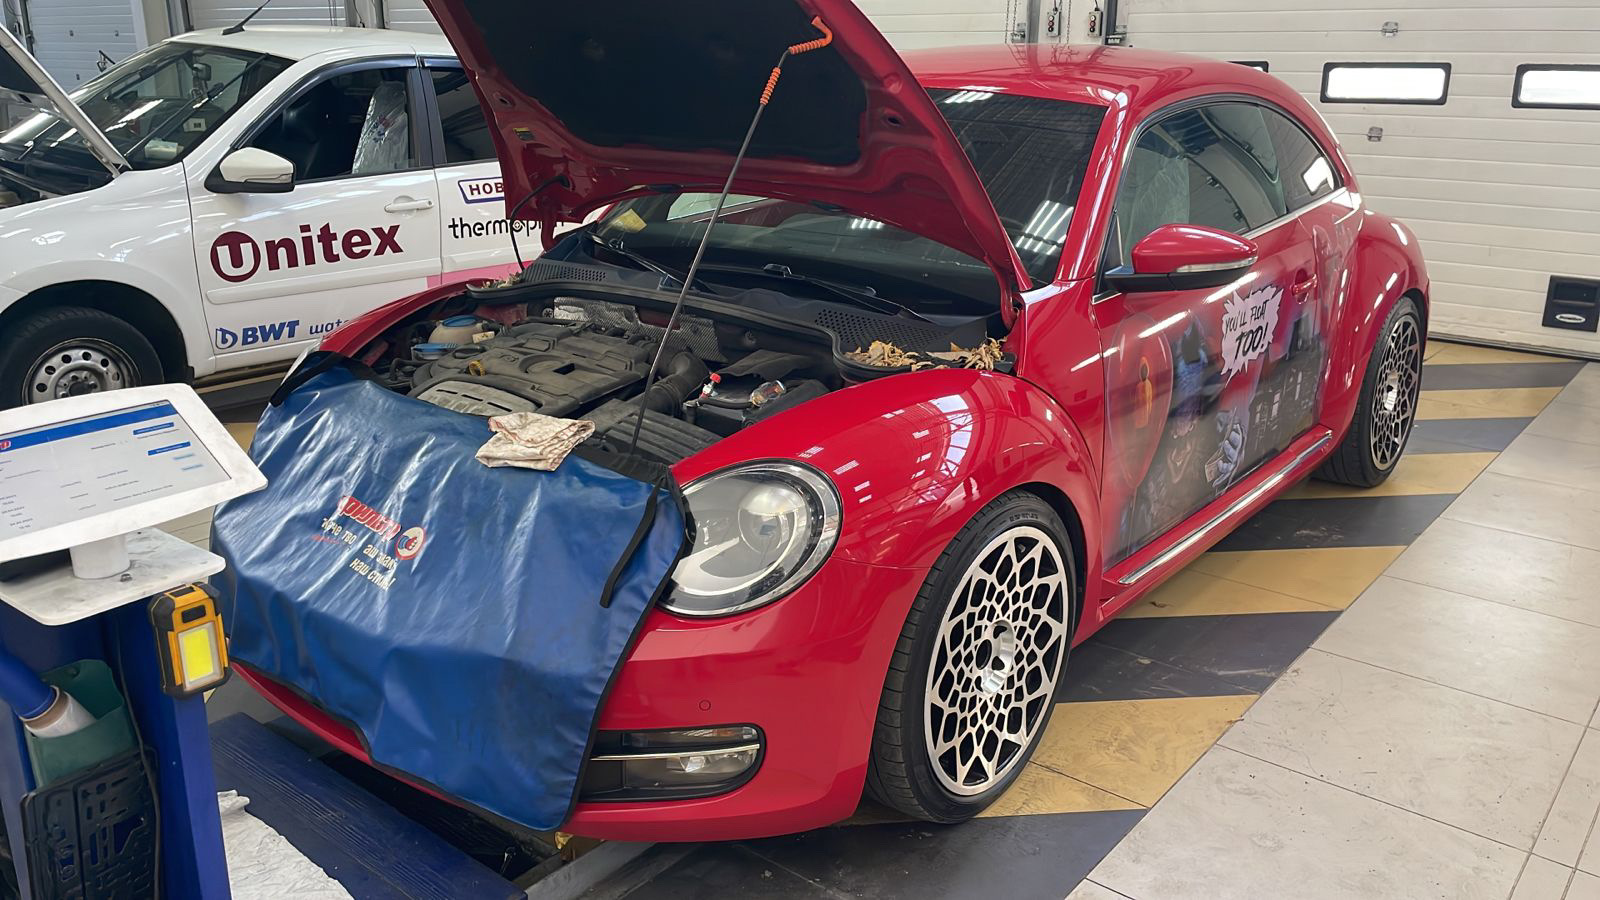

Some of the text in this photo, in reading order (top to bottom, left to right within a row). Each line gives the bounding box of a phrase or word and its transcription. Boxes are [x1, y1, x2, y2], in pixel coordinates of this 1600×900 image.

[210, 222, 404, 283] Unitex
[241, 318, 350, 346] BWT wat
[1234, 322, 1269, 361] TOO!
